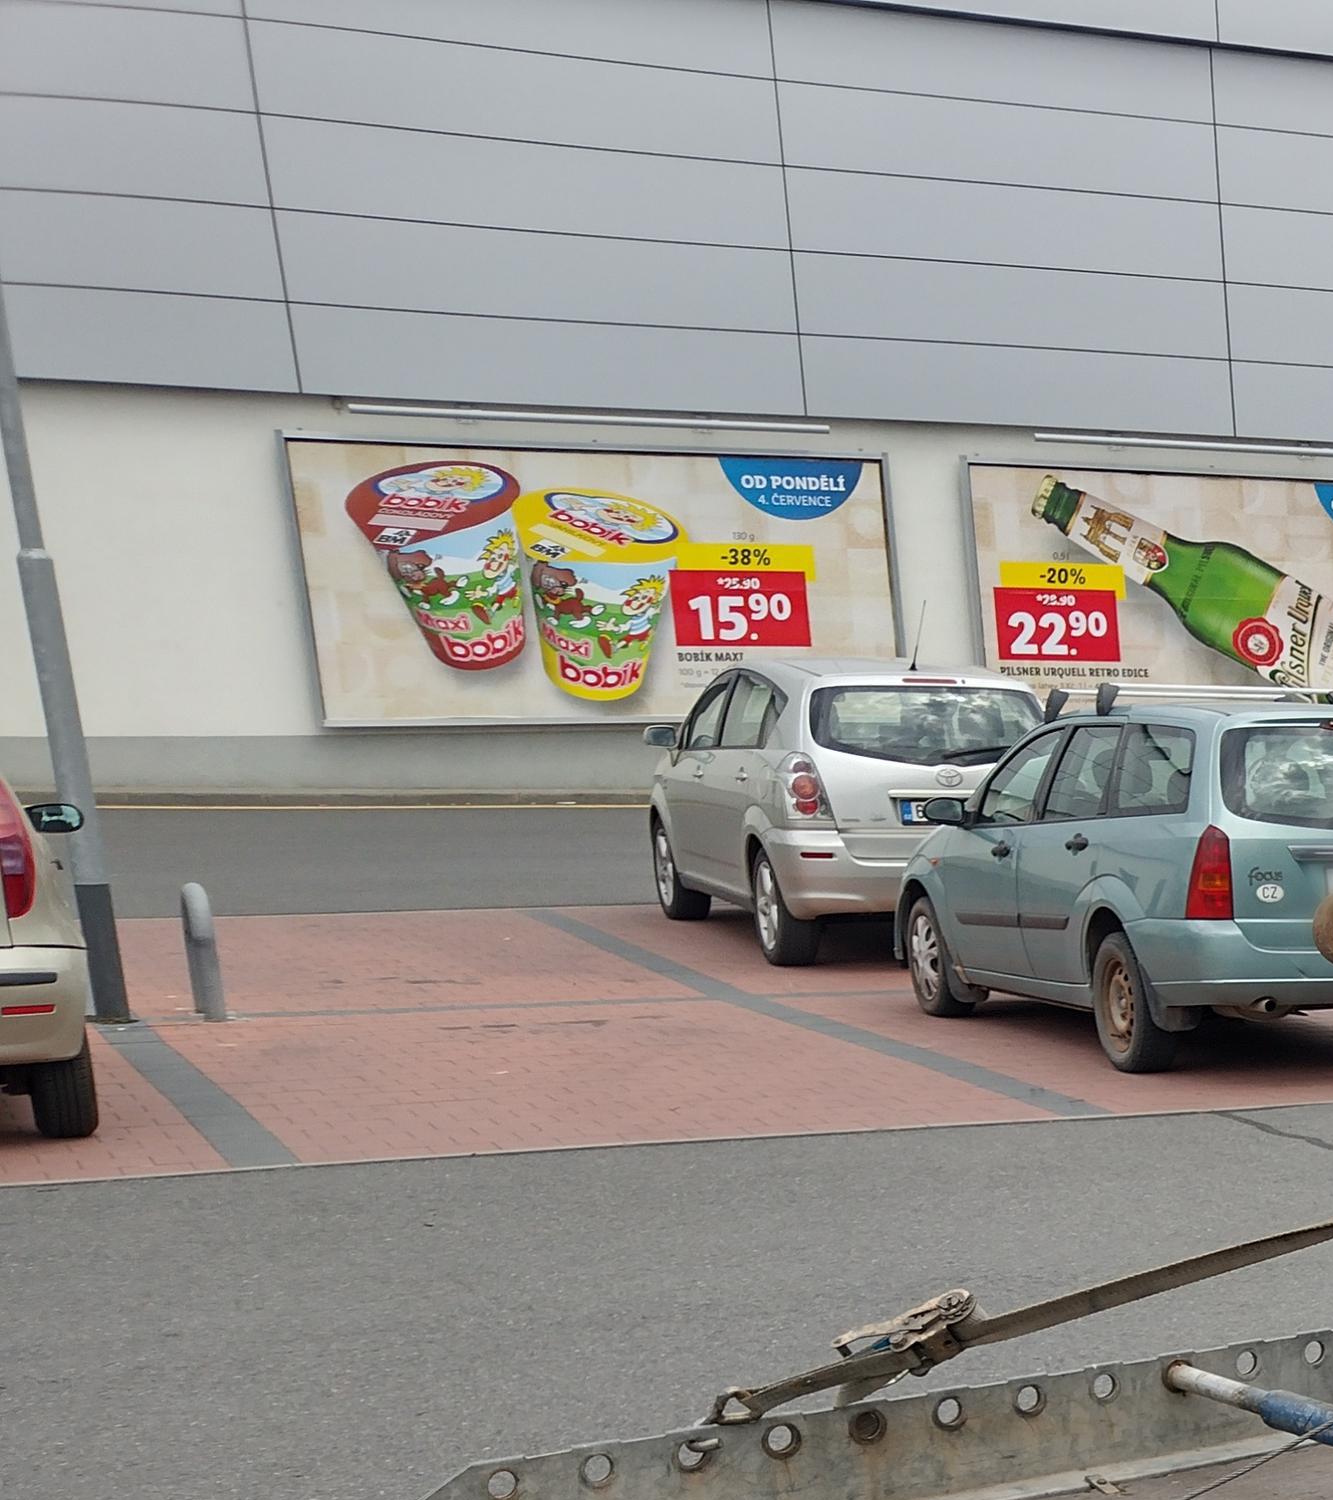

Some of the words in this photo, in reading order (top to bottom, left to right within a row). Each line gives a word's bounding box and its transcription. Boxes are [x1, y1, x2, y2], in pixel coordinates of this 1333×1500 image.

[741, 474, 767, 489] OD
[770, 475, 846, 492] PONDĚLÍ
[758, 495, 769, 505] 4.
[771, 493, 832, 507] ČERVENCE
[721, 548, 771, 566] -38%
[1040, 567, 1086, 584] -20%
[677, 650, 712, 662] BOBÍK
[714, 652, 744, 662] MAXI
[559, 653, 643, 690] bobík
[1000, 666, 1041, 677] PILSNER
[1043, 667, 1086, 679] URQUELL
[1089, 668, 1119, 678] RETRO
[1122, 668, 1149, 678] EDICE
[1262, 886, 1278, 899] CZ
